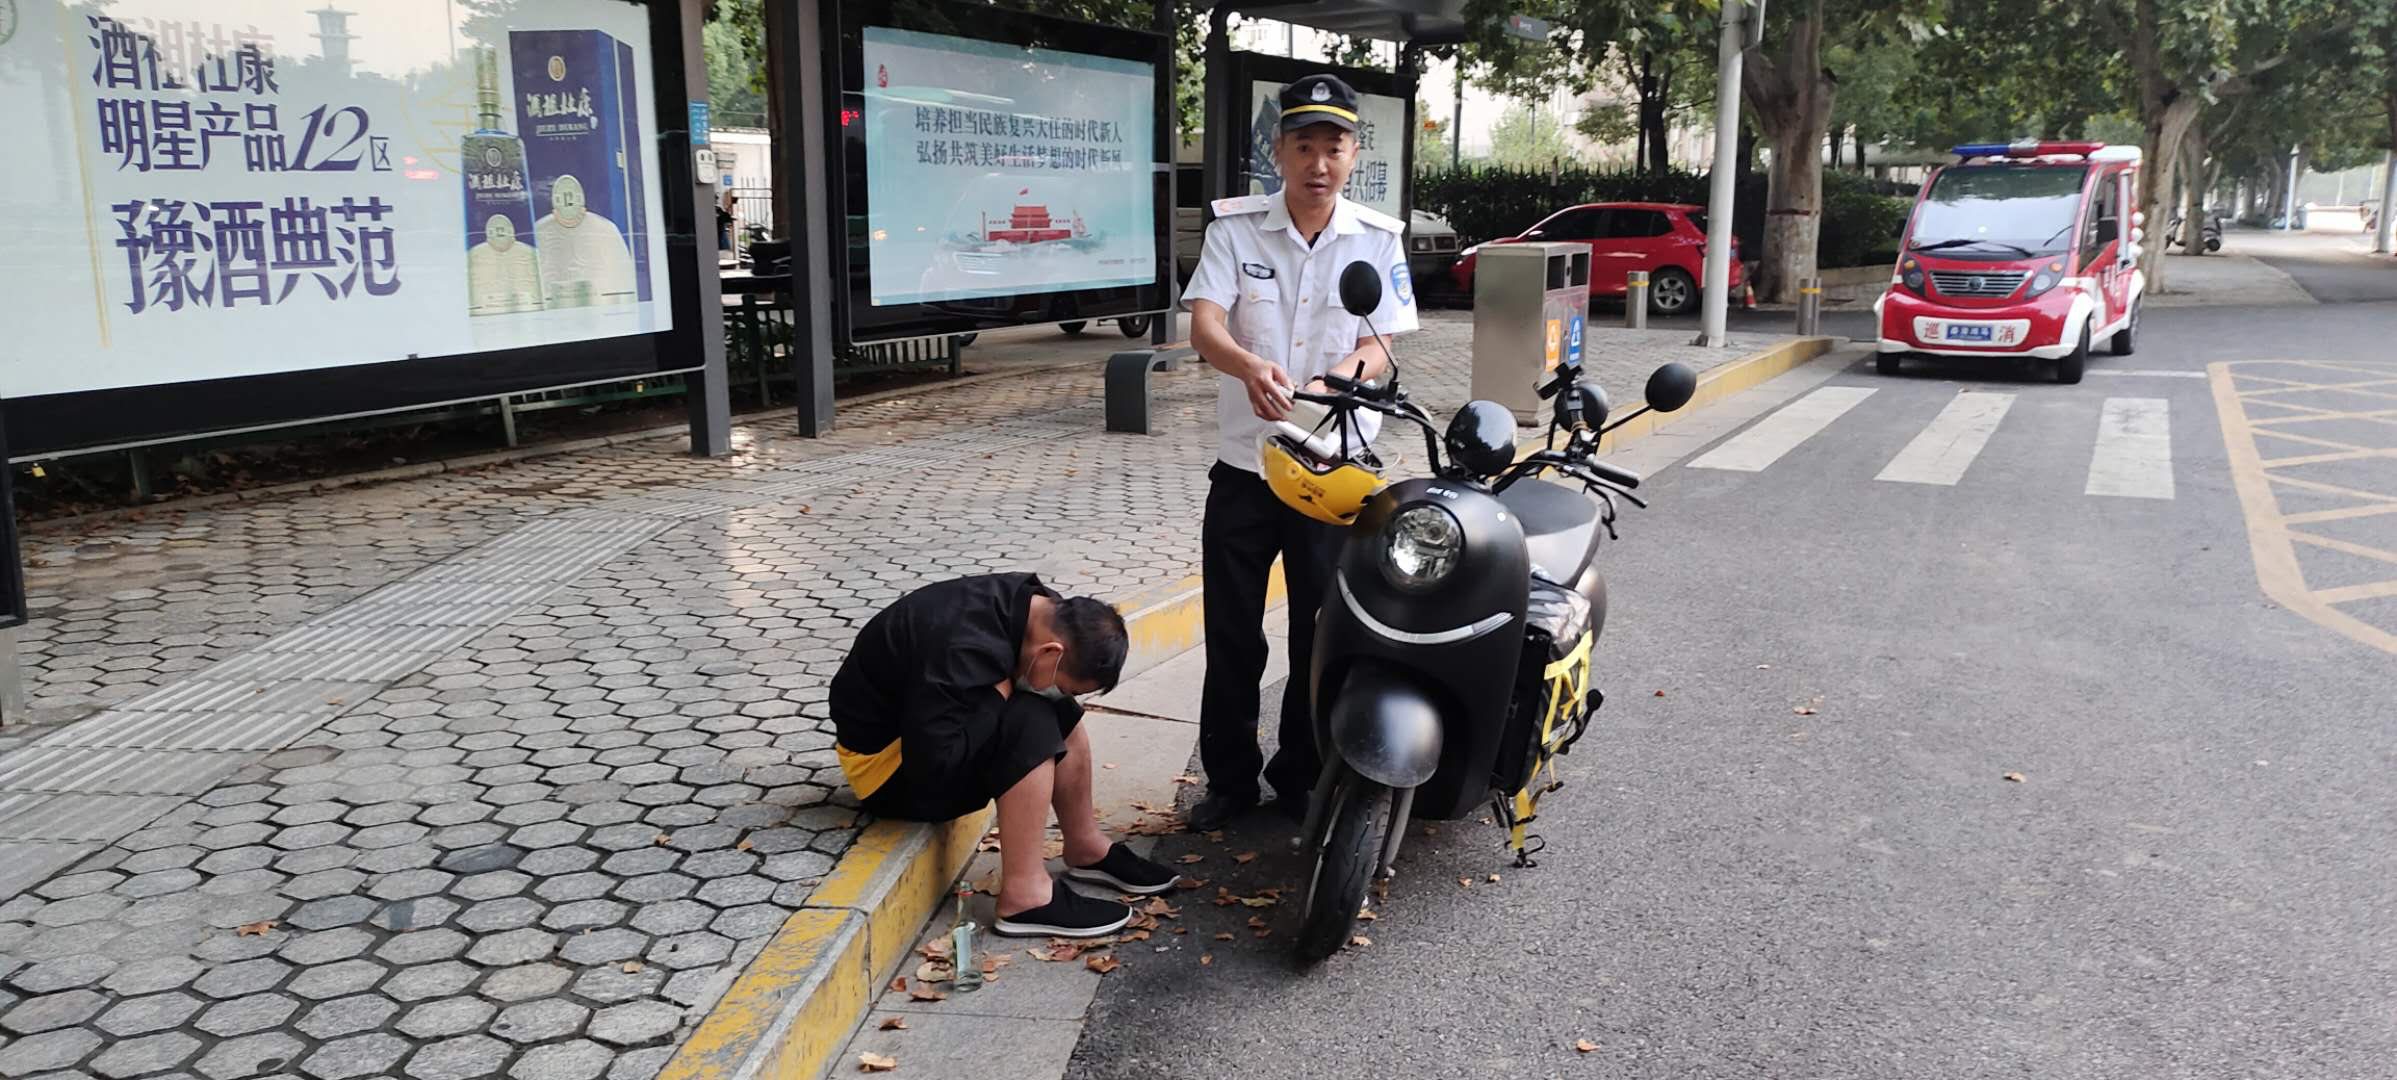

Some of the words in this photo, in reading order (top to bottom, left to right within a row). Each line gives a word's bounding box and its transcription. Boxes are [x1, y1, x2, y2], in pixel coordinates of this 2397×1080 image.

[86, 15, 280, 96] 酒祖杜康
[915, 106, 1123, 144] 培养担当民族复兴大任的时代新人
[111, 196, 402, 314] 豫酒典范
